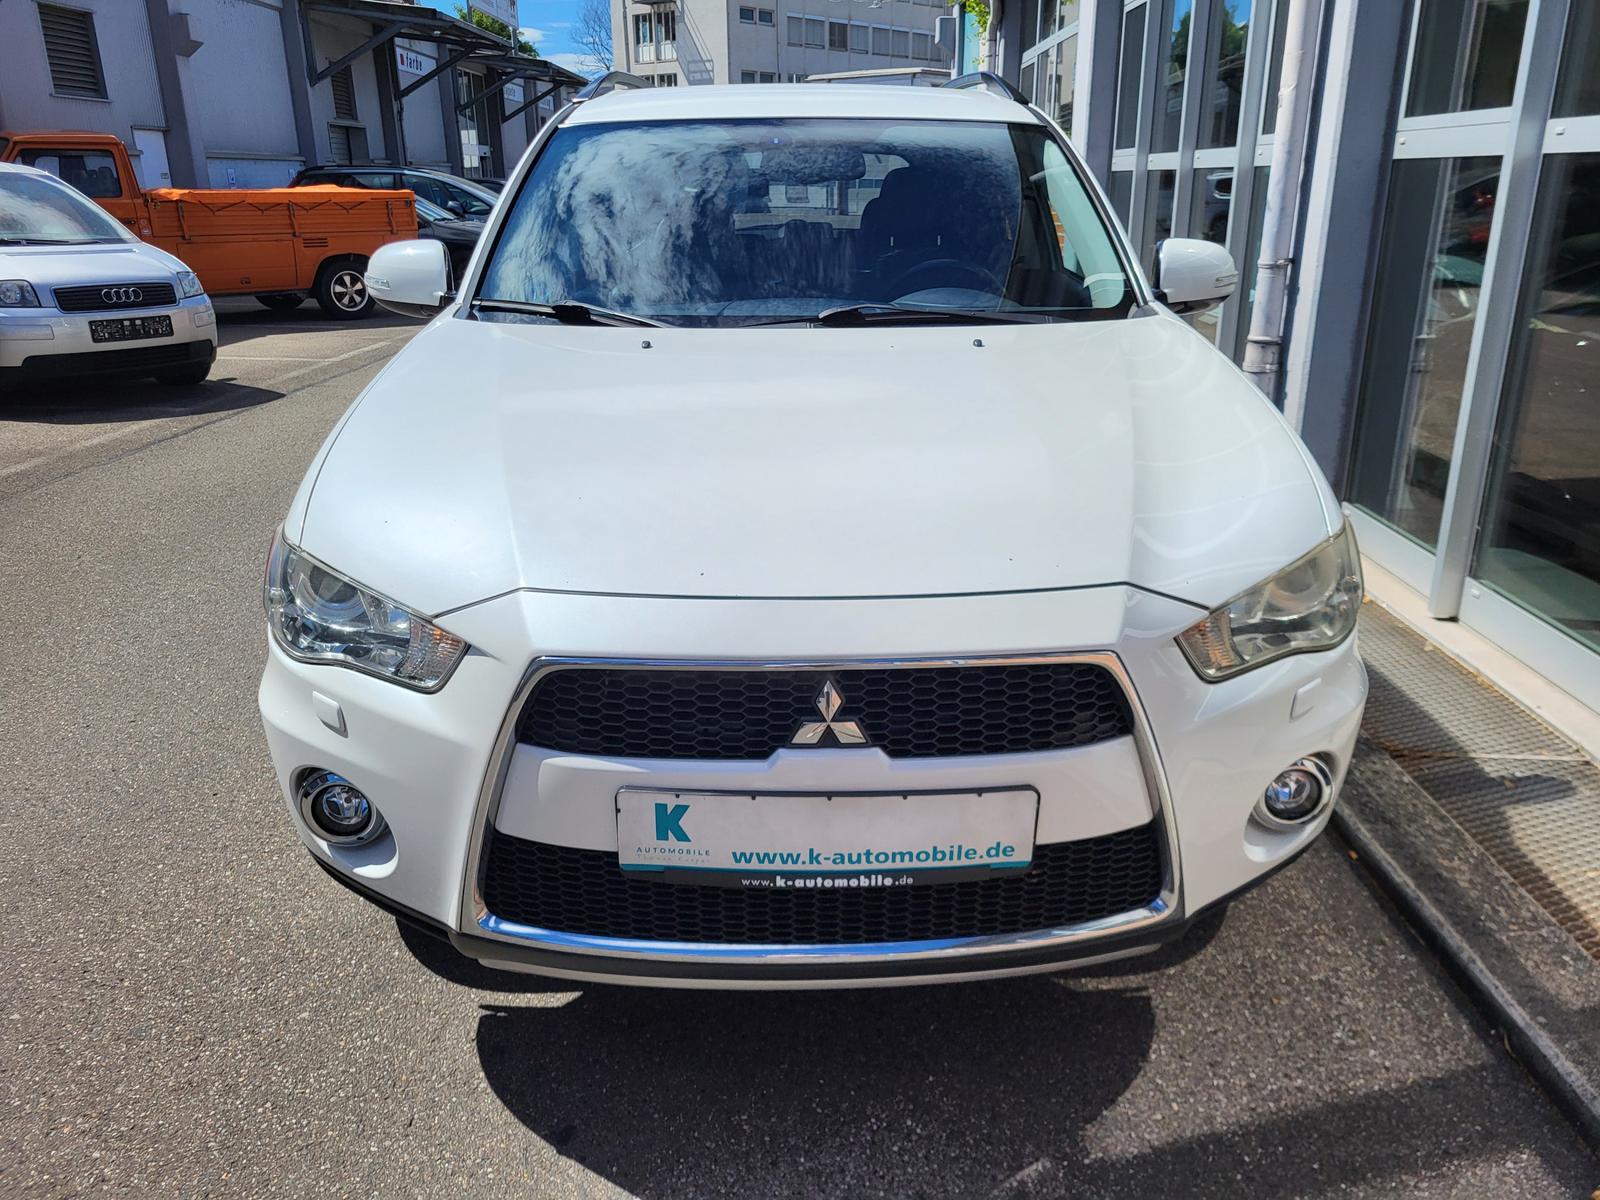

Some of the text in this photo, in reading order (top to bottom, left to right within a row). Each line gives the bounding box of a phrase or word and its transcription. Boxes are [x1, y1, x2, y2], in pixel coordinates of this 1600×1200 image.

[406, 52, 422, 71] farbe
[655, 803, 692, 842] K
[636, 847, 711, 856] AUTOMOBILE
[731, 841, 1015, 865] www.k-automobile.de
[741, 875, 914, 888] www.k-automobile.de
